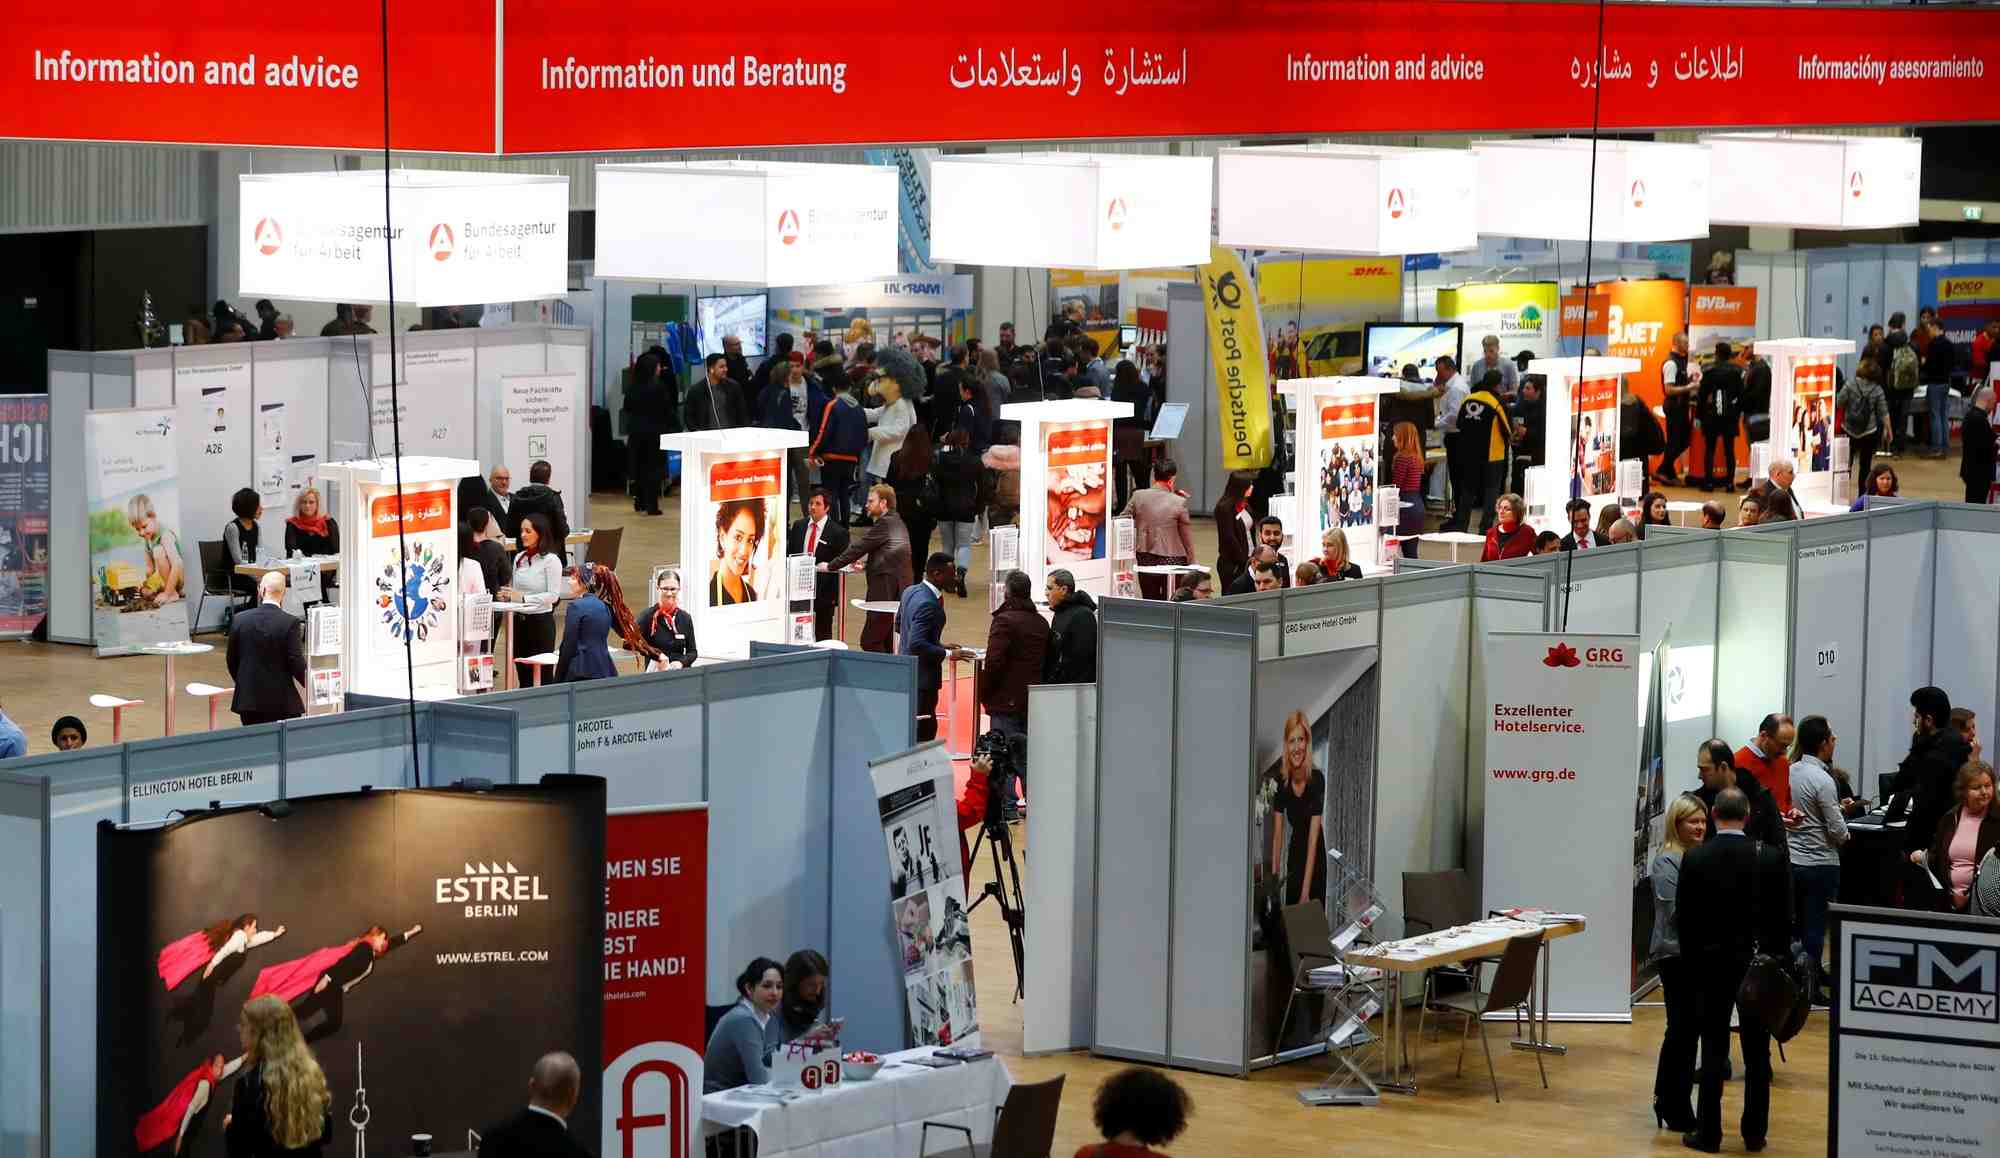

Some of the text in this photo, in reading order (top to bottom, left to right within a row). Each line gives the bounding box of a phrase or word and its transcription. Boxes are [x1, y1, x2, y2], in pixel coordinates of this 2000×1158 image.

[34, 50, 359, 89] Information and advice
[950, 47, 1187, 96] استشارة واستعلامات
[1287, 53, 1485, 81] Information and advice
[1674, 43, 1744, 81] اطلاعات
[1798, 53, 1984, 86] Informacióny asesoramiento
[542, 55, 847, 93] Information und Beratung
[1647, 60, 1659, 88] و
[1352, 264, 1387, 277] DHL
[204, 444, 223, 454] A26
[1286, 616, 1357, 634] GRG Service Hotel GmbH
[1585, 648, 1624, 663] GRG
[1818, 650, 1835, 666] D10
[1494, 704, 1574, 718] Exzellenter
[577, 720, 614, 733] ARCOTEL
[1494, 720, 1585, 734] Hotelservice.
[577, 728, 673, 752] John F & ARCOTEL Velvet
[133, 770, 253, 797] ELLINGTON HOTEL BERLIN
[1492, 767, 1576, 783] www.grg.de
[651, 856, 681, 876] SIE
[436, 875, 549, 904] ESTREL
[464, 904, 518, 918] BERLIN
[605, 908, 660, 930] RIERE
[627, 956, 686, 979] HAND!
[1854, 937, 1997, 993] FM
[1857, 985, 1993, 1017] ACADEMY
[1848, 1081, 1862, 1089] Mit
[1864, 1082, 1905, 1094] Sicherheit
[1907, 1087, 1920, 1096] auf
[1922, 1088, 1941, 1097] dem
[1943, 1090, 1978, 1102] richtigen
